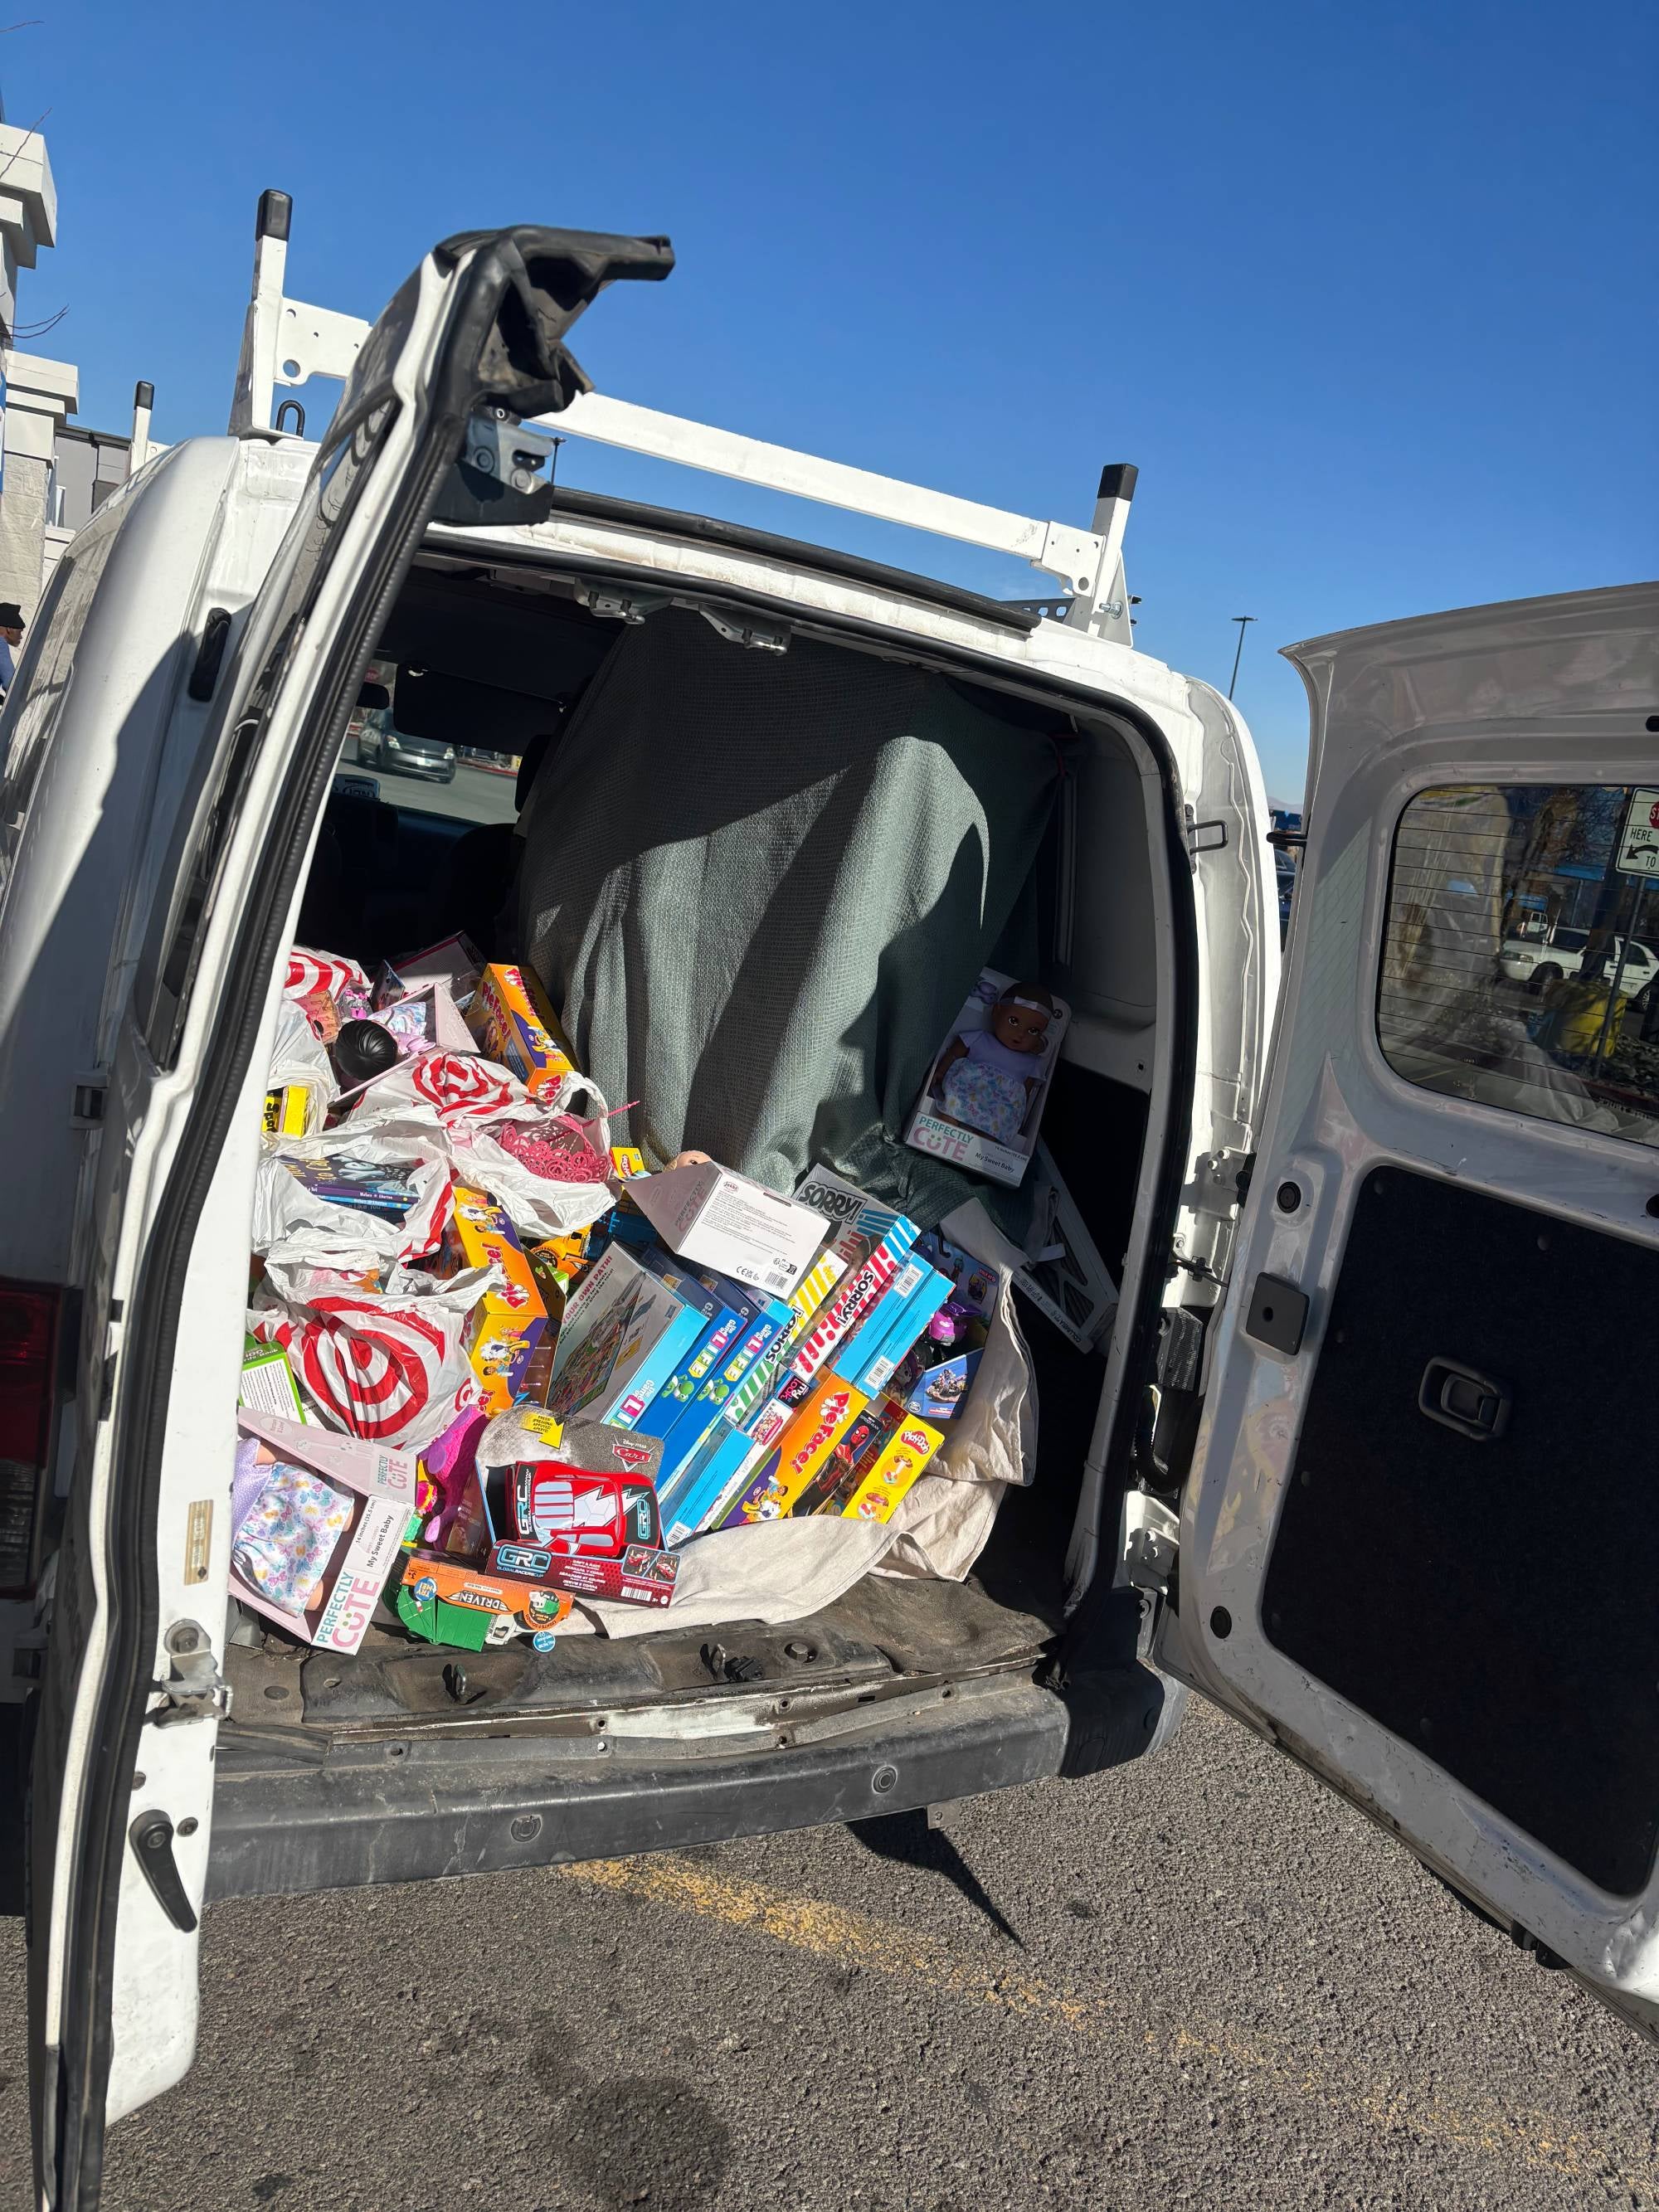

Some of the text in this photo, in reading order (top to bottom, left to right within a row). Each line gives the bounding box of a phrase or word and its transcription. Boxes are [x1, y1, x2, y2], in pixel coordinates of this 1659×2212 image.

[1650, 807, 1659, 821] ST
[1630, 828, 1652, 842] HERE
[1646, 856, 1657, 868] TO
[543, 1075, 562, 1100] Pie
[914, 1127, 968, 1161] CUTE
[919, 1116, 974, 1144] PERFECTLY
[975, 1153, 1015, 1173] My Sweet Baby
[676, 1179, 703, 1226] PERFECTLY
[679, 1191, 705, 1232] CUTE
[798, 1184, 863, 1222] SORRY!
[500, 1282, 526, 1309] Pie
[563, 1256, 612, 1324] YOUR OWN PATH!
[837, 1271, 873, 1324] SORRY!
[245, 1349, 263, 1358] 100
[691, 1334, 726, 1375] LIFE
[727, 1339, 761, 1378] LIFE
[781, 1377, 801, 1400] LOOK
[791, 1383, 807, 1400] my
[611, 1398, 642, 1428] LI
[790, 1392, 850, 1475] Pie Face!
[903, 1431, 929, 1454] Play-Doh
[377, 1455, 388, 1485] PERFECTLY
[617, 1449, 646, 1461] Cars
[387, 1460, 408, 1490] CUTE
[517, 1485, 530, 1535] GRC
[638, 1500, 649, 1538] GRC
[358, 1520, 368, 1539] inches
[367, 1554, 377, 1568] My
[372, 1534, 384, 1556] Sweet
[381, 1514, 395, 1534] Baby
[504, 1549, 547, 1570] GRC
[420, 1583, 433, 1592] ME!
[459, 1592, 502, 1610] DRIVEN
[317, 1571, 354, 1644] PERFECTLY
[332, 1578, 380, 1648] CUTE
